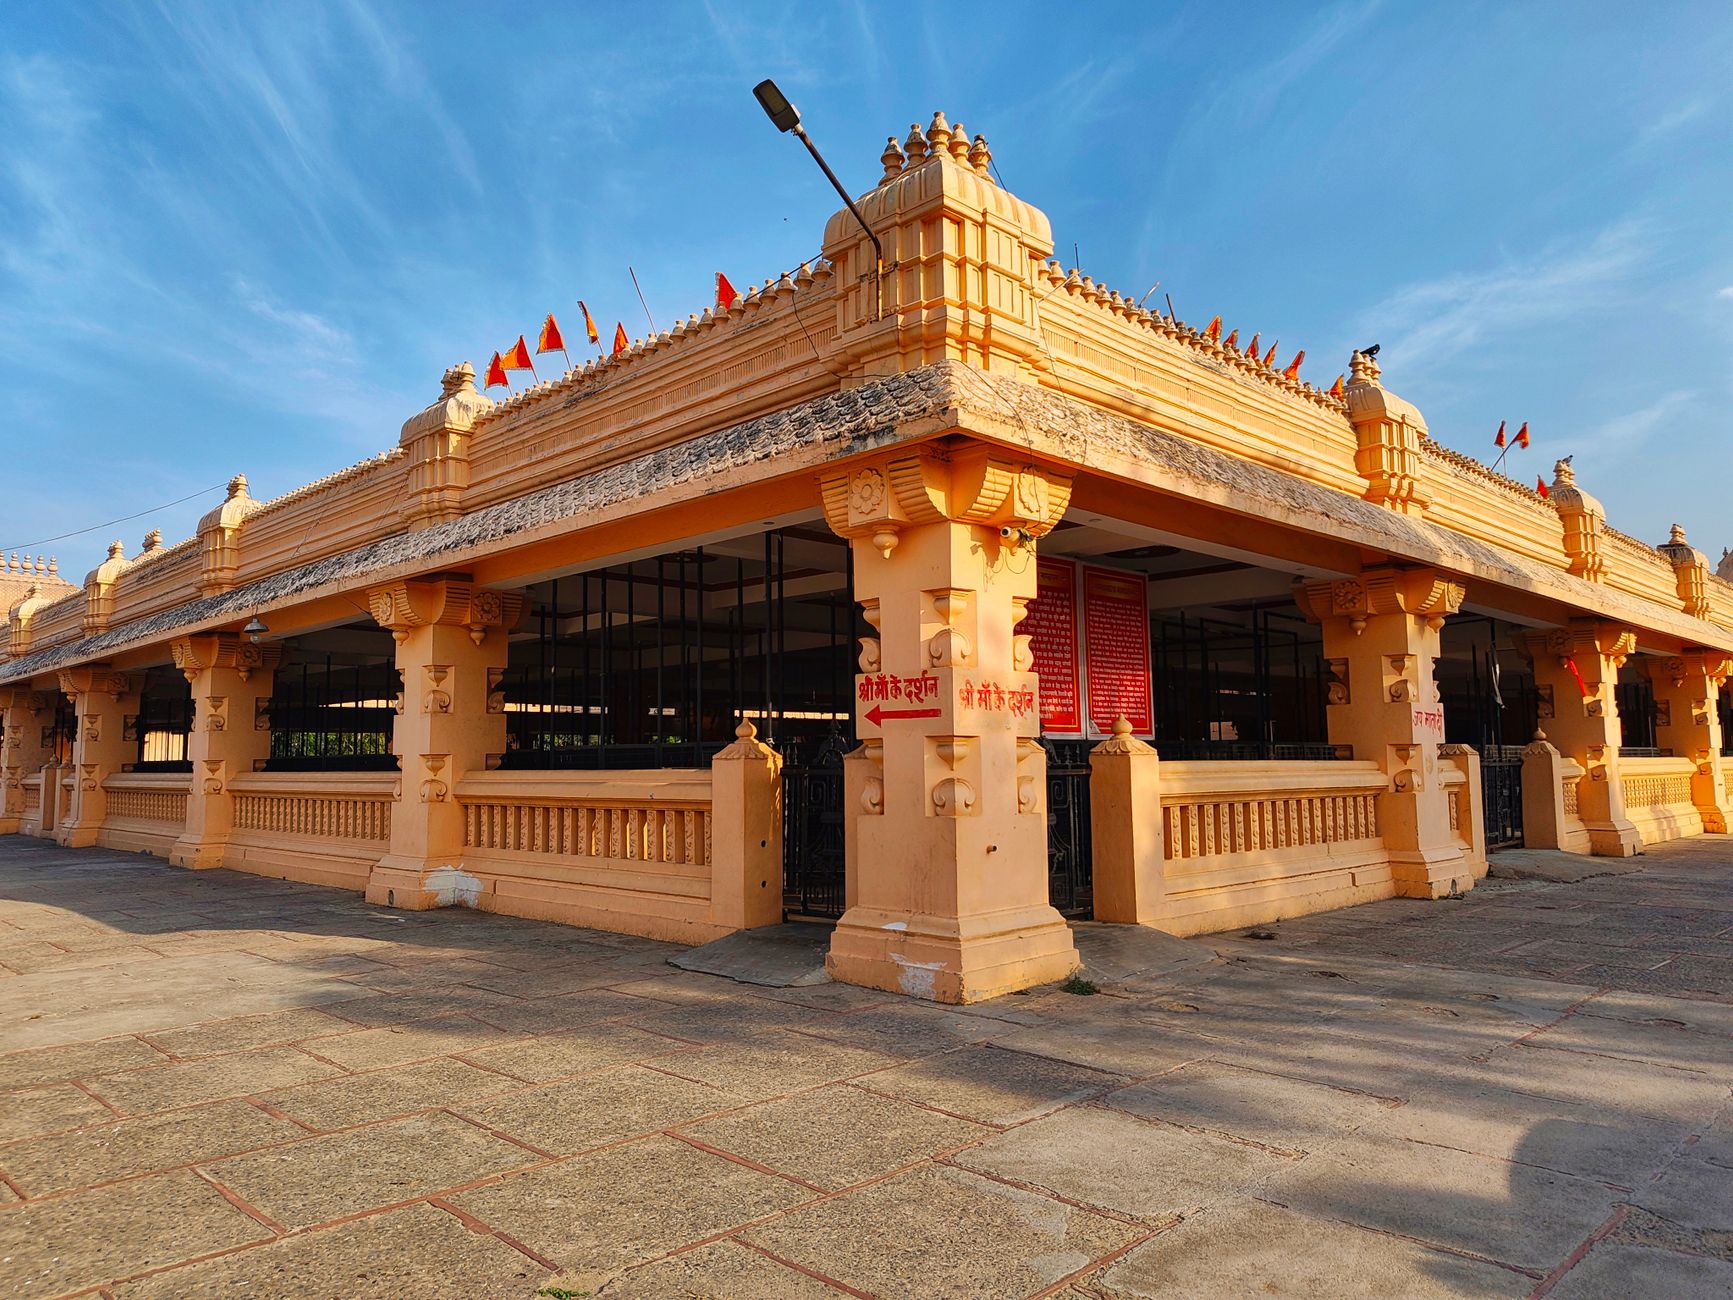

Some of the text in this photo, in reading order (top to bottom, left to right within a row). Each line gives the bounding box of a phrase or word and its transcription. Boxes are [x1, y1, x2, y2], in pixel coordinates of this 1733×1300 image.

[859, 675, 874, 702] श्री
[890, 674, 902, 699] के
[903, 670, 940, 704] दर्शन
[993, 682, 1006, 711] के
[1007, 684, 1035, 717] दर्शन
